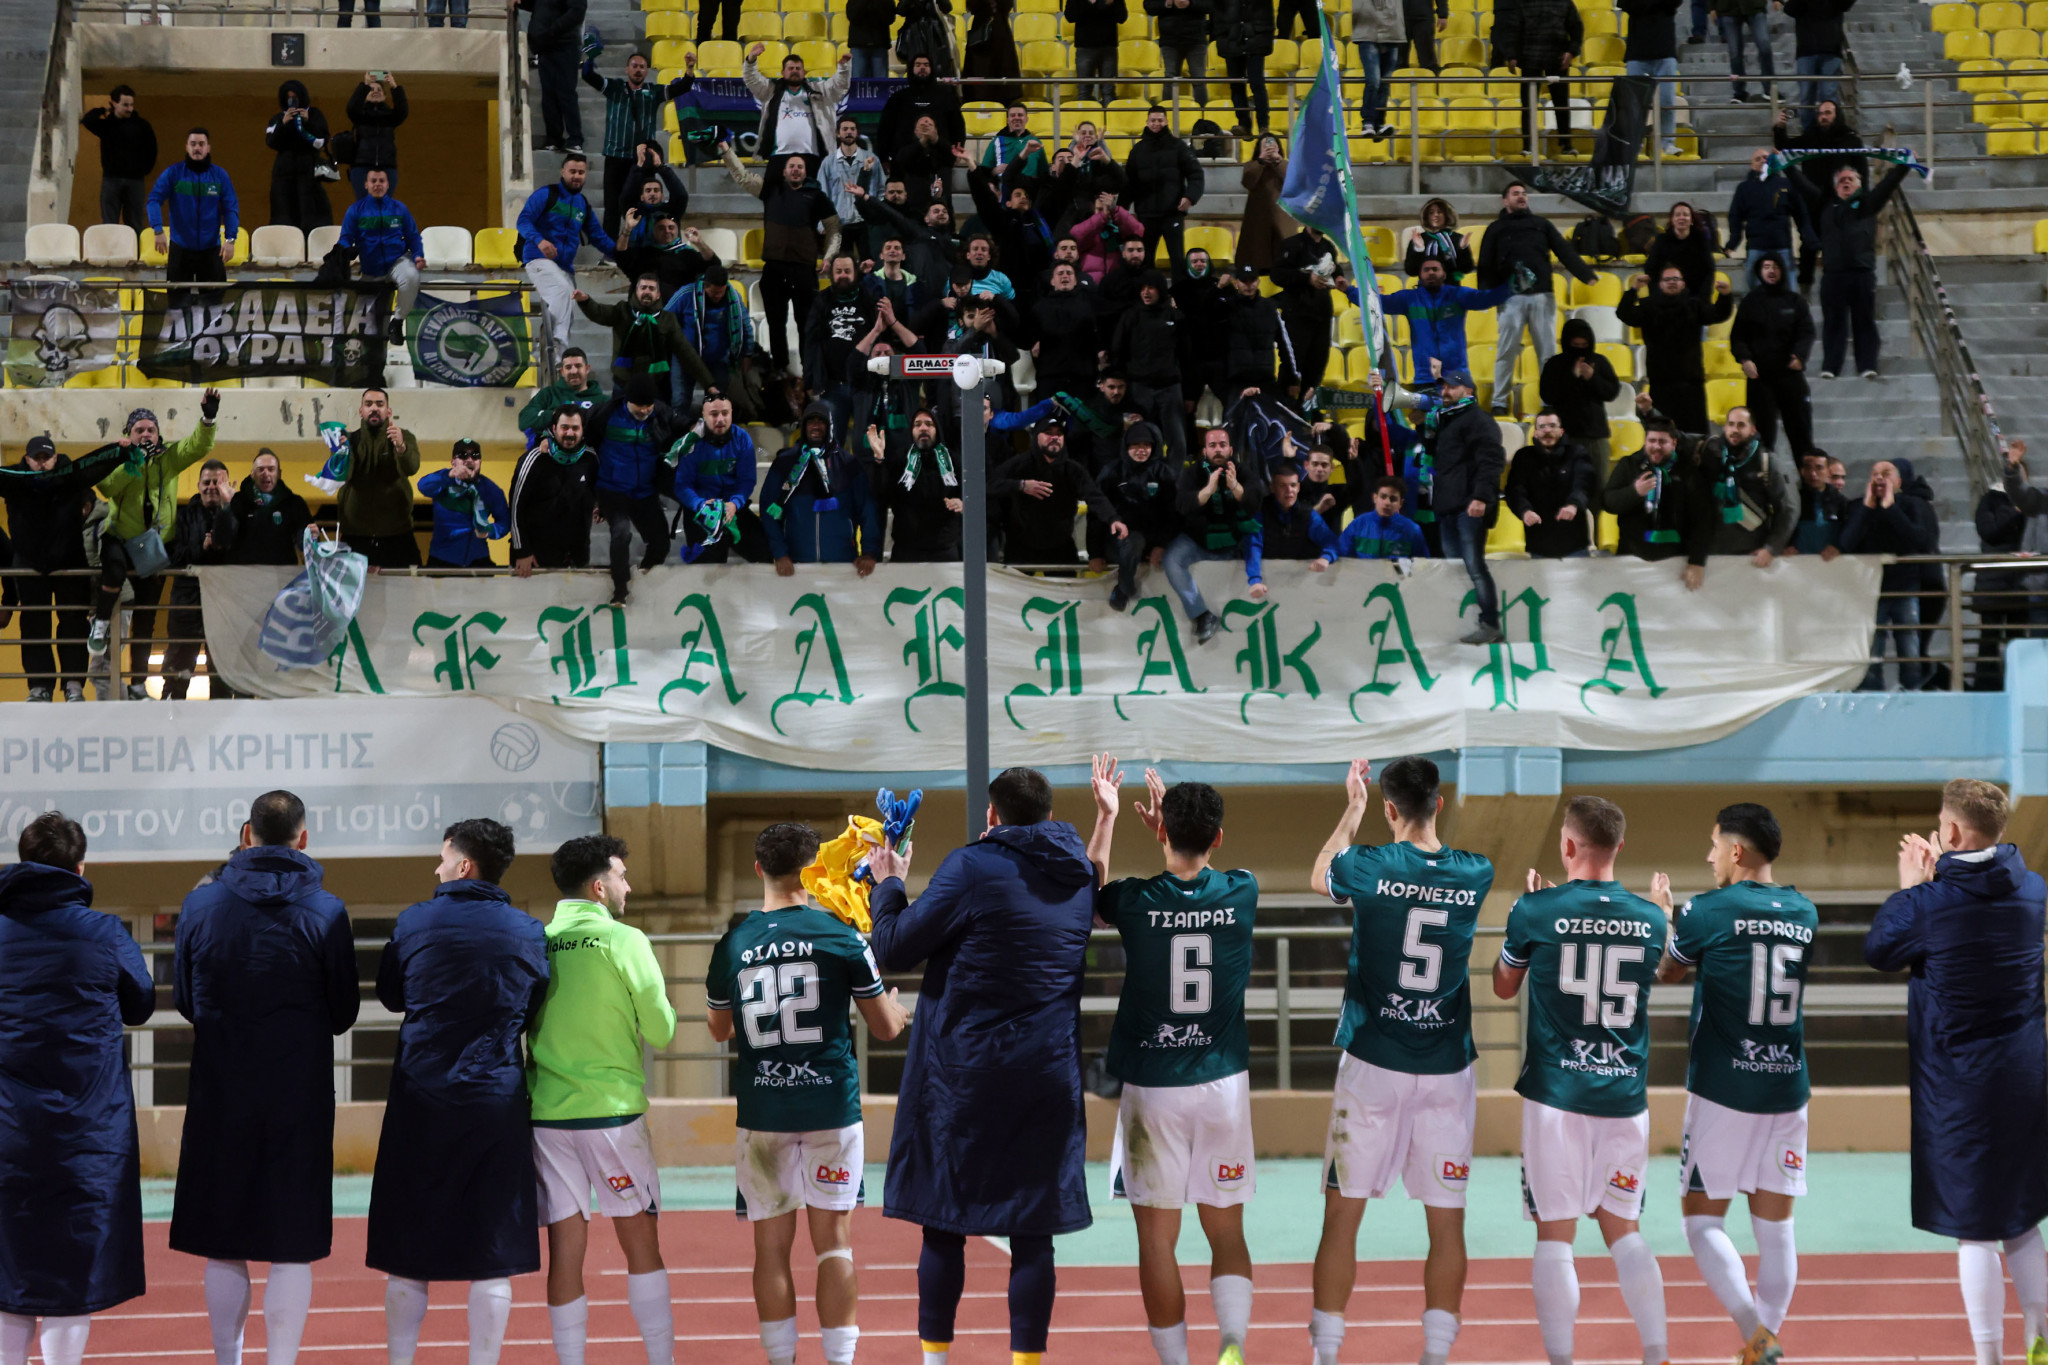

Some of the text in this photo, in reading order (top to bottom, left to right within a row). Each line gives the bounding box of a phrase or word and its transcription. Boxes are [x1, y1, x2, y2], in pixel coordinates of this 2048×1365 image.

[908, 359, 954, 368] ARMAOS
[208, 732, 374, 772] ΚΡΗΤΗΣ
[80, 807, 184, 839] στον
[200, 795, 441, 842] αθτισμό!
[1377, 879, 1477, 906] ΚΟΡΝΕΖΟΣ
[1148, 908, 1236, 928] ΤΣΑΠΡΑΣ
[1734, 920, 1813, 943] PEDROZO
[741, 941, 813, 964] ΦΙΛΩΝ
[1399, 907, 1449, 993] 5
[1170, 933, 1213, 1014] 6
[1559, 943, 1645, 1029] 45
[1748, 943, 1804, 1026] 15
[738, 961, 823, 1049] 22
[1561, 1059, 1639, 1077] PROPERTIES
[608, 1173, 632, 1189] Dol
[816, 1165, 850, 1182] Dole
[1219, 1163, 1245, 1180] Dole
